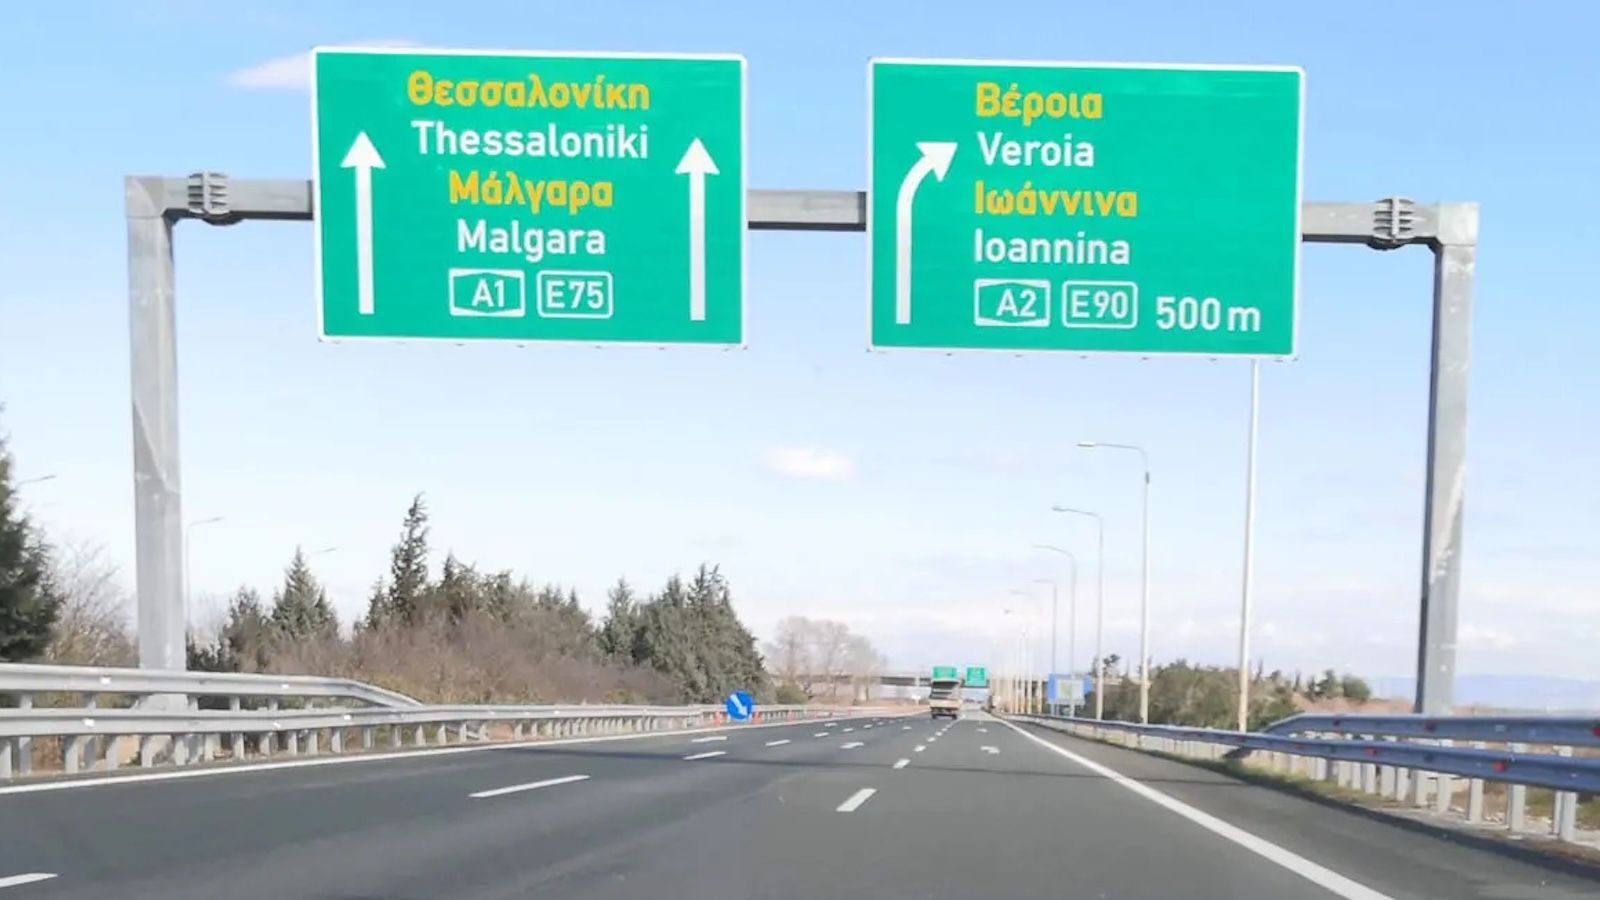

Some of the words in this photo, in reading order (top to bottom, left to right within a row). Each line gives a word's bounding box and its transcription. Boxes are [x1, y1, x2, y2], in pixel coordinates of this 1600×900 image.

[408, 71, 649, 109] Θεσσαλονίκη
[977, 83, 1102, 126] Βέροια
[412, 121, 647, 158] Thessaloniki
[978, 132, 1094, 167] Veroia
[450, 171, 612, 214] Μάλγαρα
[976, 181, 1137, 217] Ιωάννινα
[458, 219, 605, 262] Malgara
[975, 229, 1129, 264] Ioannina
[472, 280, 504, 307] A1
[547, 280, 603, 308] E75
[997, 289, 1036, 317] A2
[1072, 290, 1128, 318] E90
[1157, 297, 1220, 330] 500
[1228, 307, 1260, 331] m
